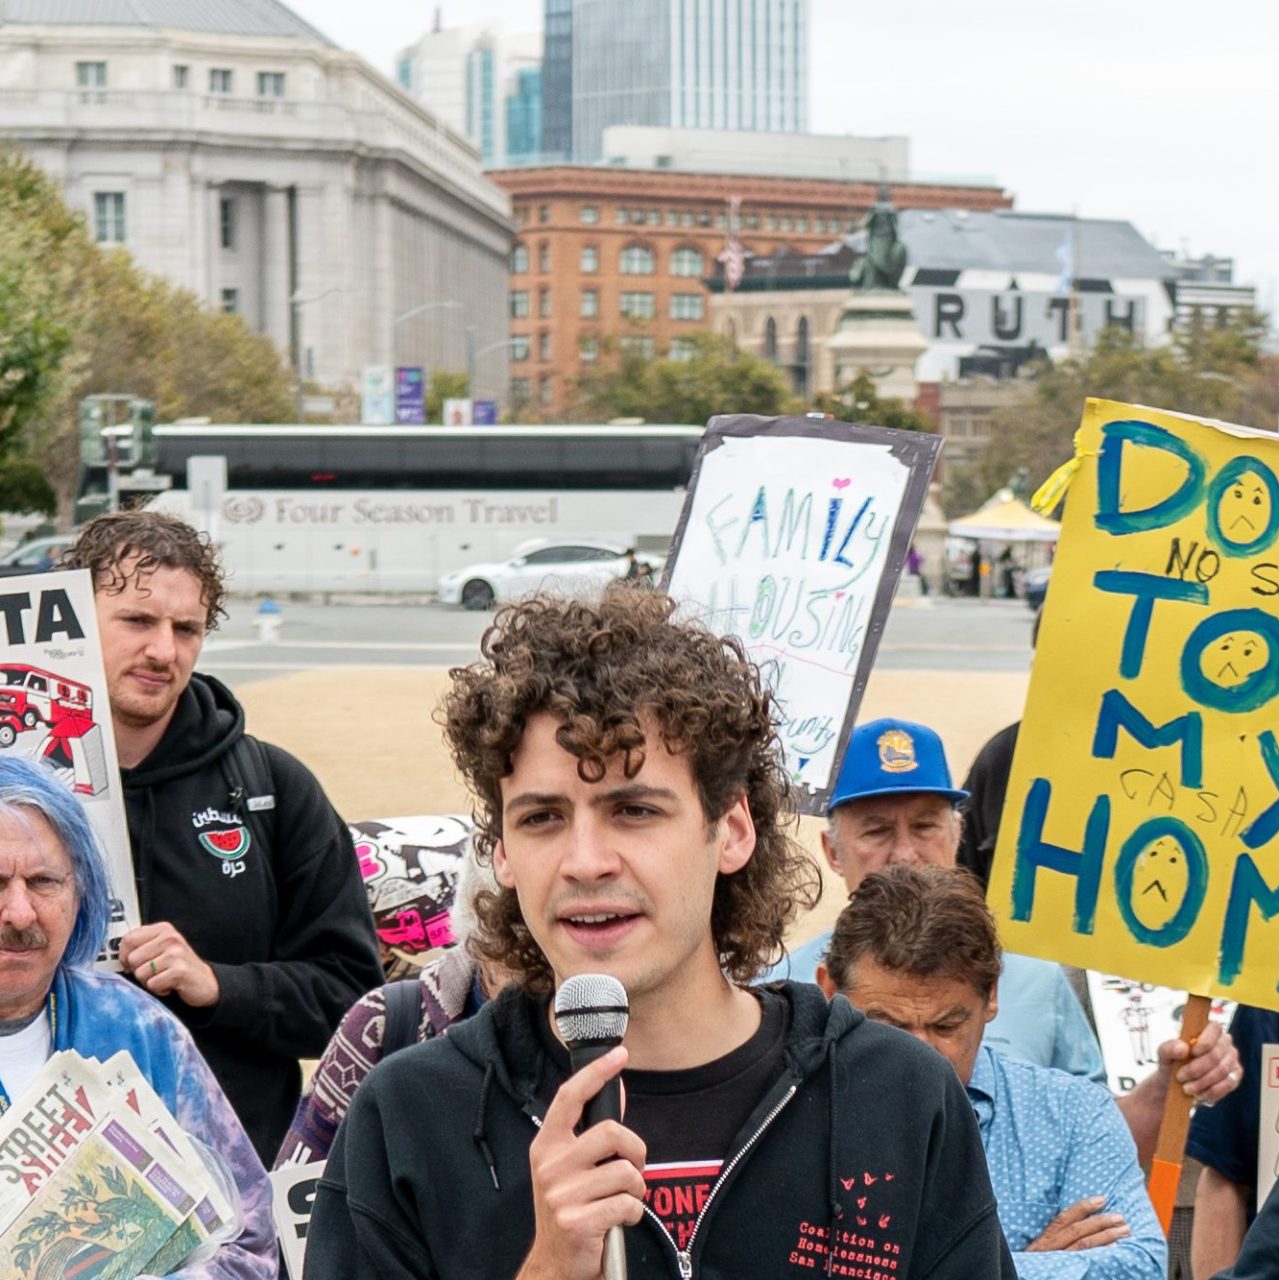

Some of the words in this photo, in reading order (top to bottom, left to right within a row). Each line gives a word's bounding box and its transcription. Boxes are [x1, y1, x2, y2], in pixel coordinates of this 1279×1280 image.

[274, 497, 341, 525] Four
[351, 497, 457, 525] Season
[461, 496, 559, 525] Travel
[1165, 537, 1222, 584] NO
[1120, 768, 1250, 839] CASA
[797, 1237, 898, 1270] Homelessness
[799, 1221, 875, 1249] Coaition
[883, 1242, 900, 1255] on
[789, 1251, 816, 1268] San
